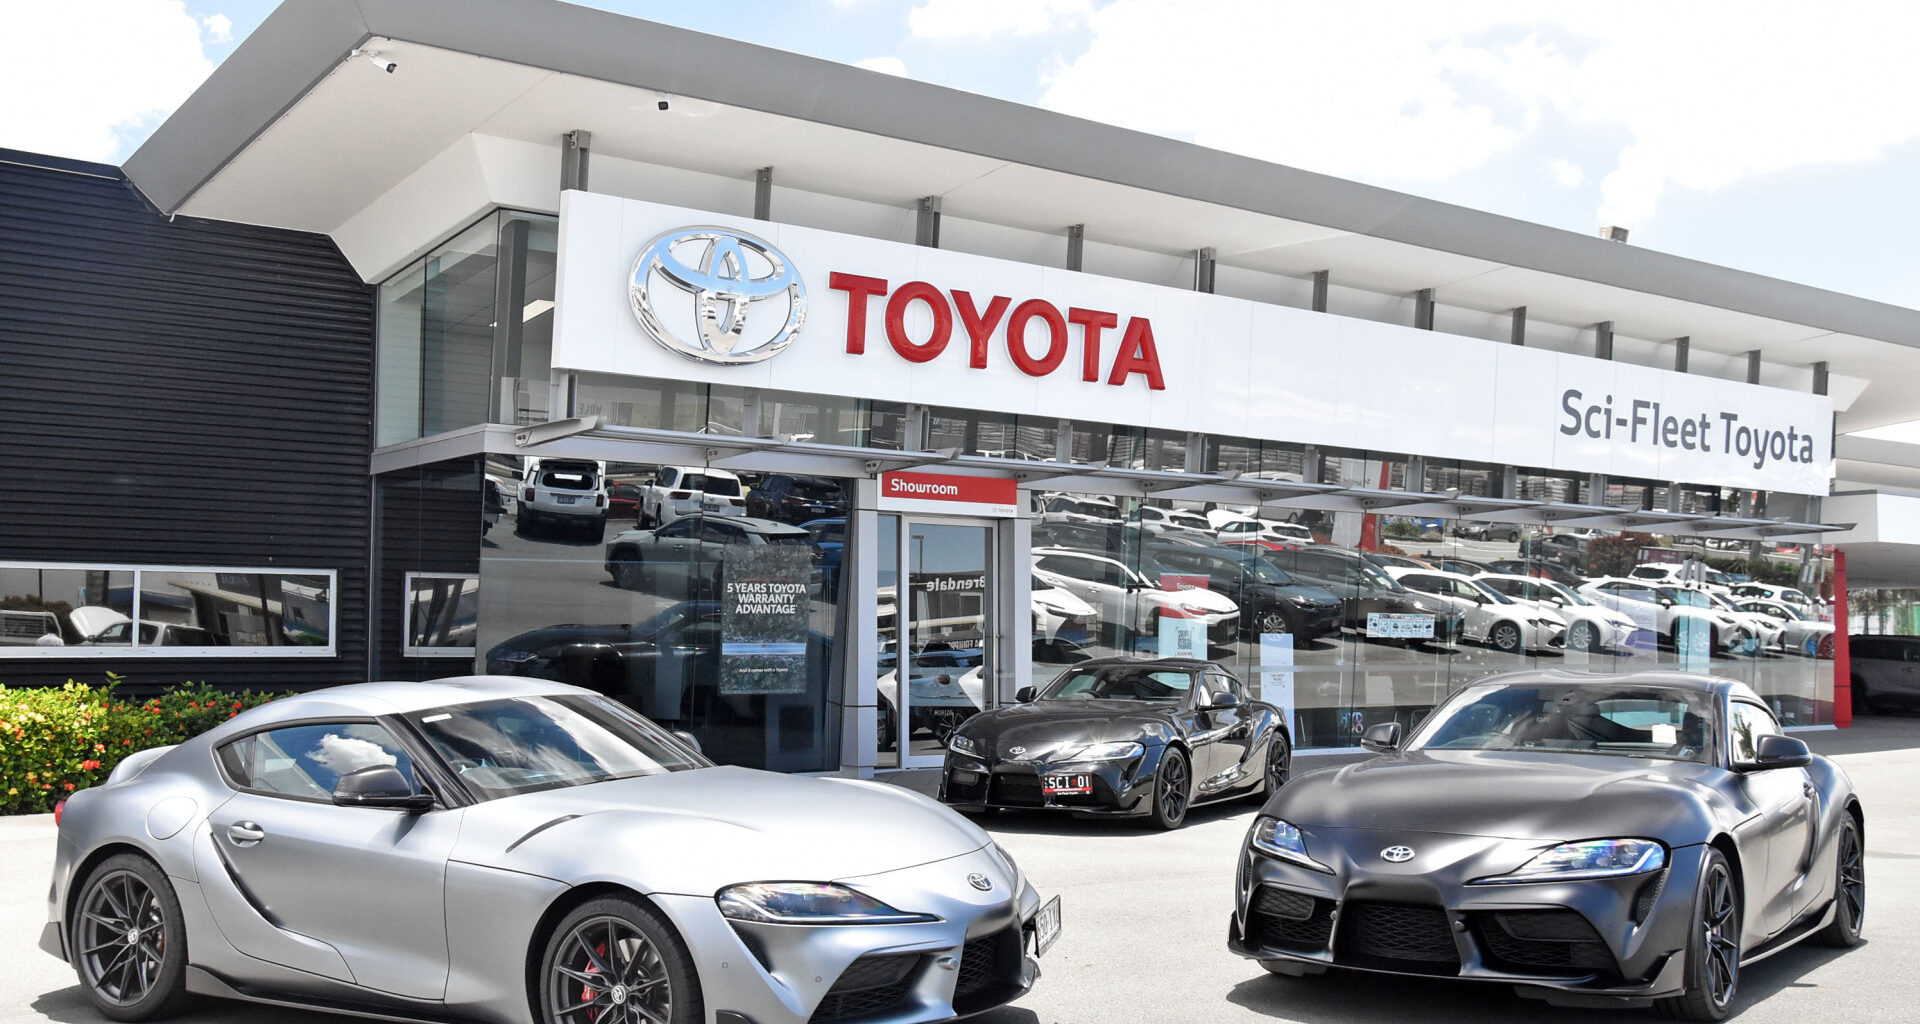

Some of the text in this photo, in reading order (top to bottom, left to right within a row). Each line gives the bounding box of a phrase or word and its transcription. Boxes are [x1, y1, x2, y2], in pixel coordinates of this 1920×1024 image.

[829, 270, 1166, 390] TOYOTA
[1559, 388, 1814, 470] Sci-Fleet Toyota
[890, 477, 959, 496] Showroom
[727, 583, 806, 594] 5 YEARS TOYOTA
[738, 594, 795, 603] WARRANTY
[1048, 776, 1070, 789] SCI
